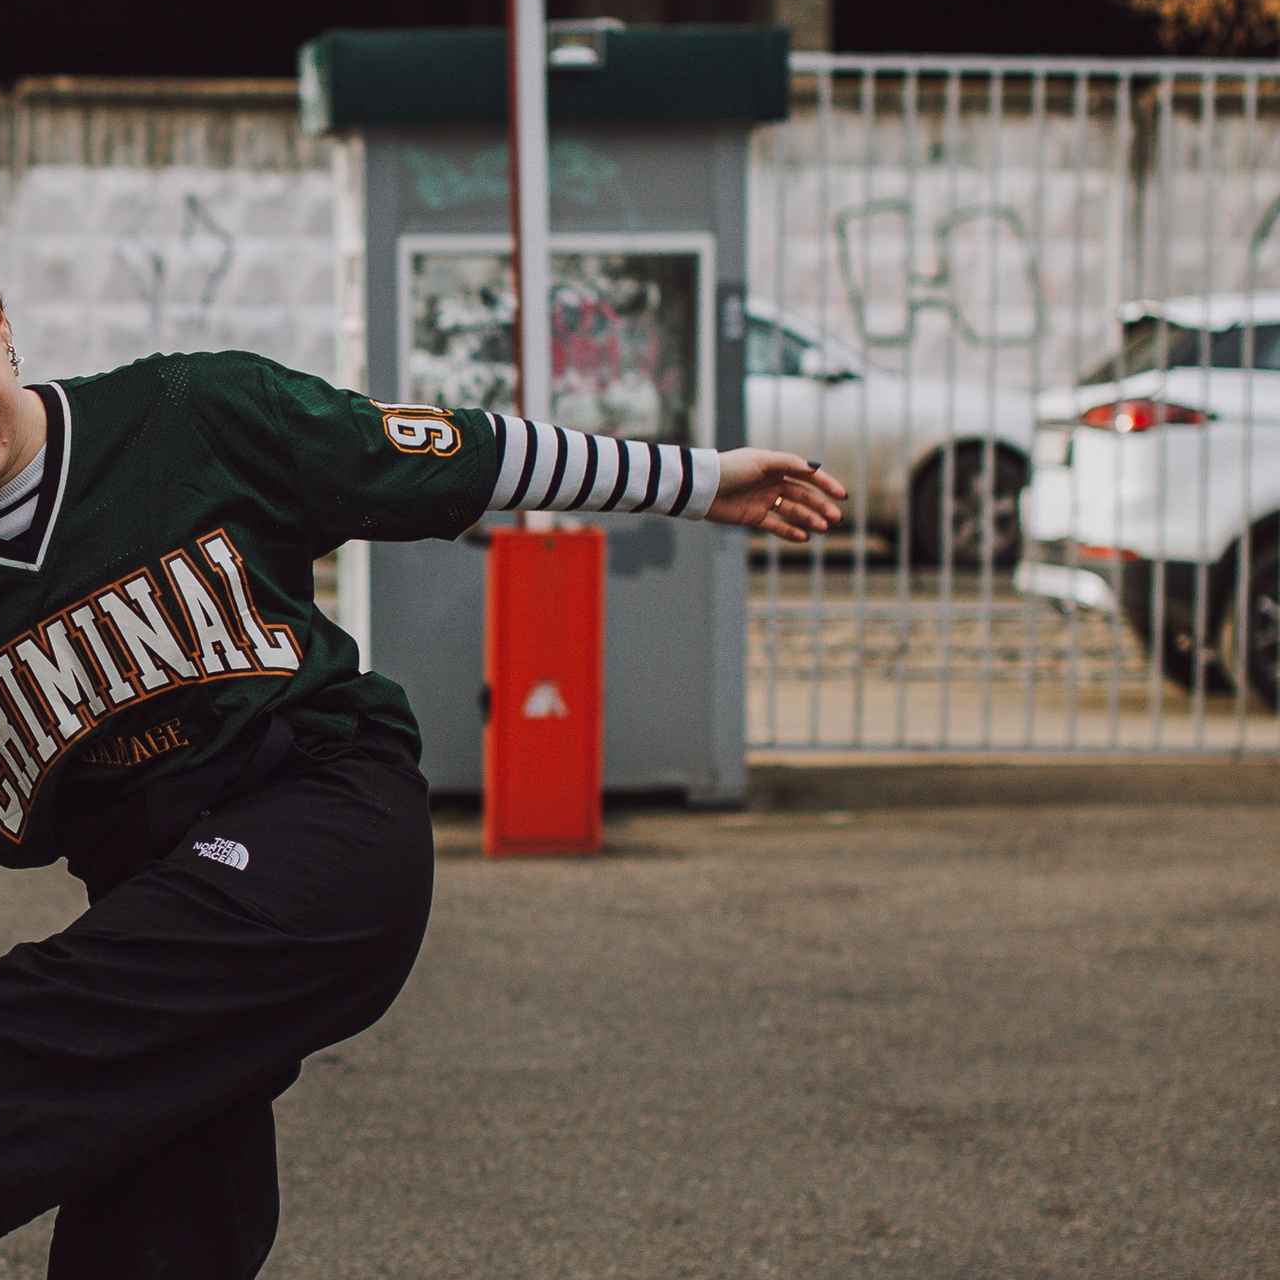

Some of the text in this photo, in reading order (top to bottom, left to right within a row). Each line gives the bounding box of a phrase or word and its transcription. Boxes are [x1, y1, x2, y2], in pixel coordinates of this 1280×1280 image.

[193, 841, 233, 857] NORTH
[214, 837, 236, 850] THE
[198, 849, 228, 864] FACE
